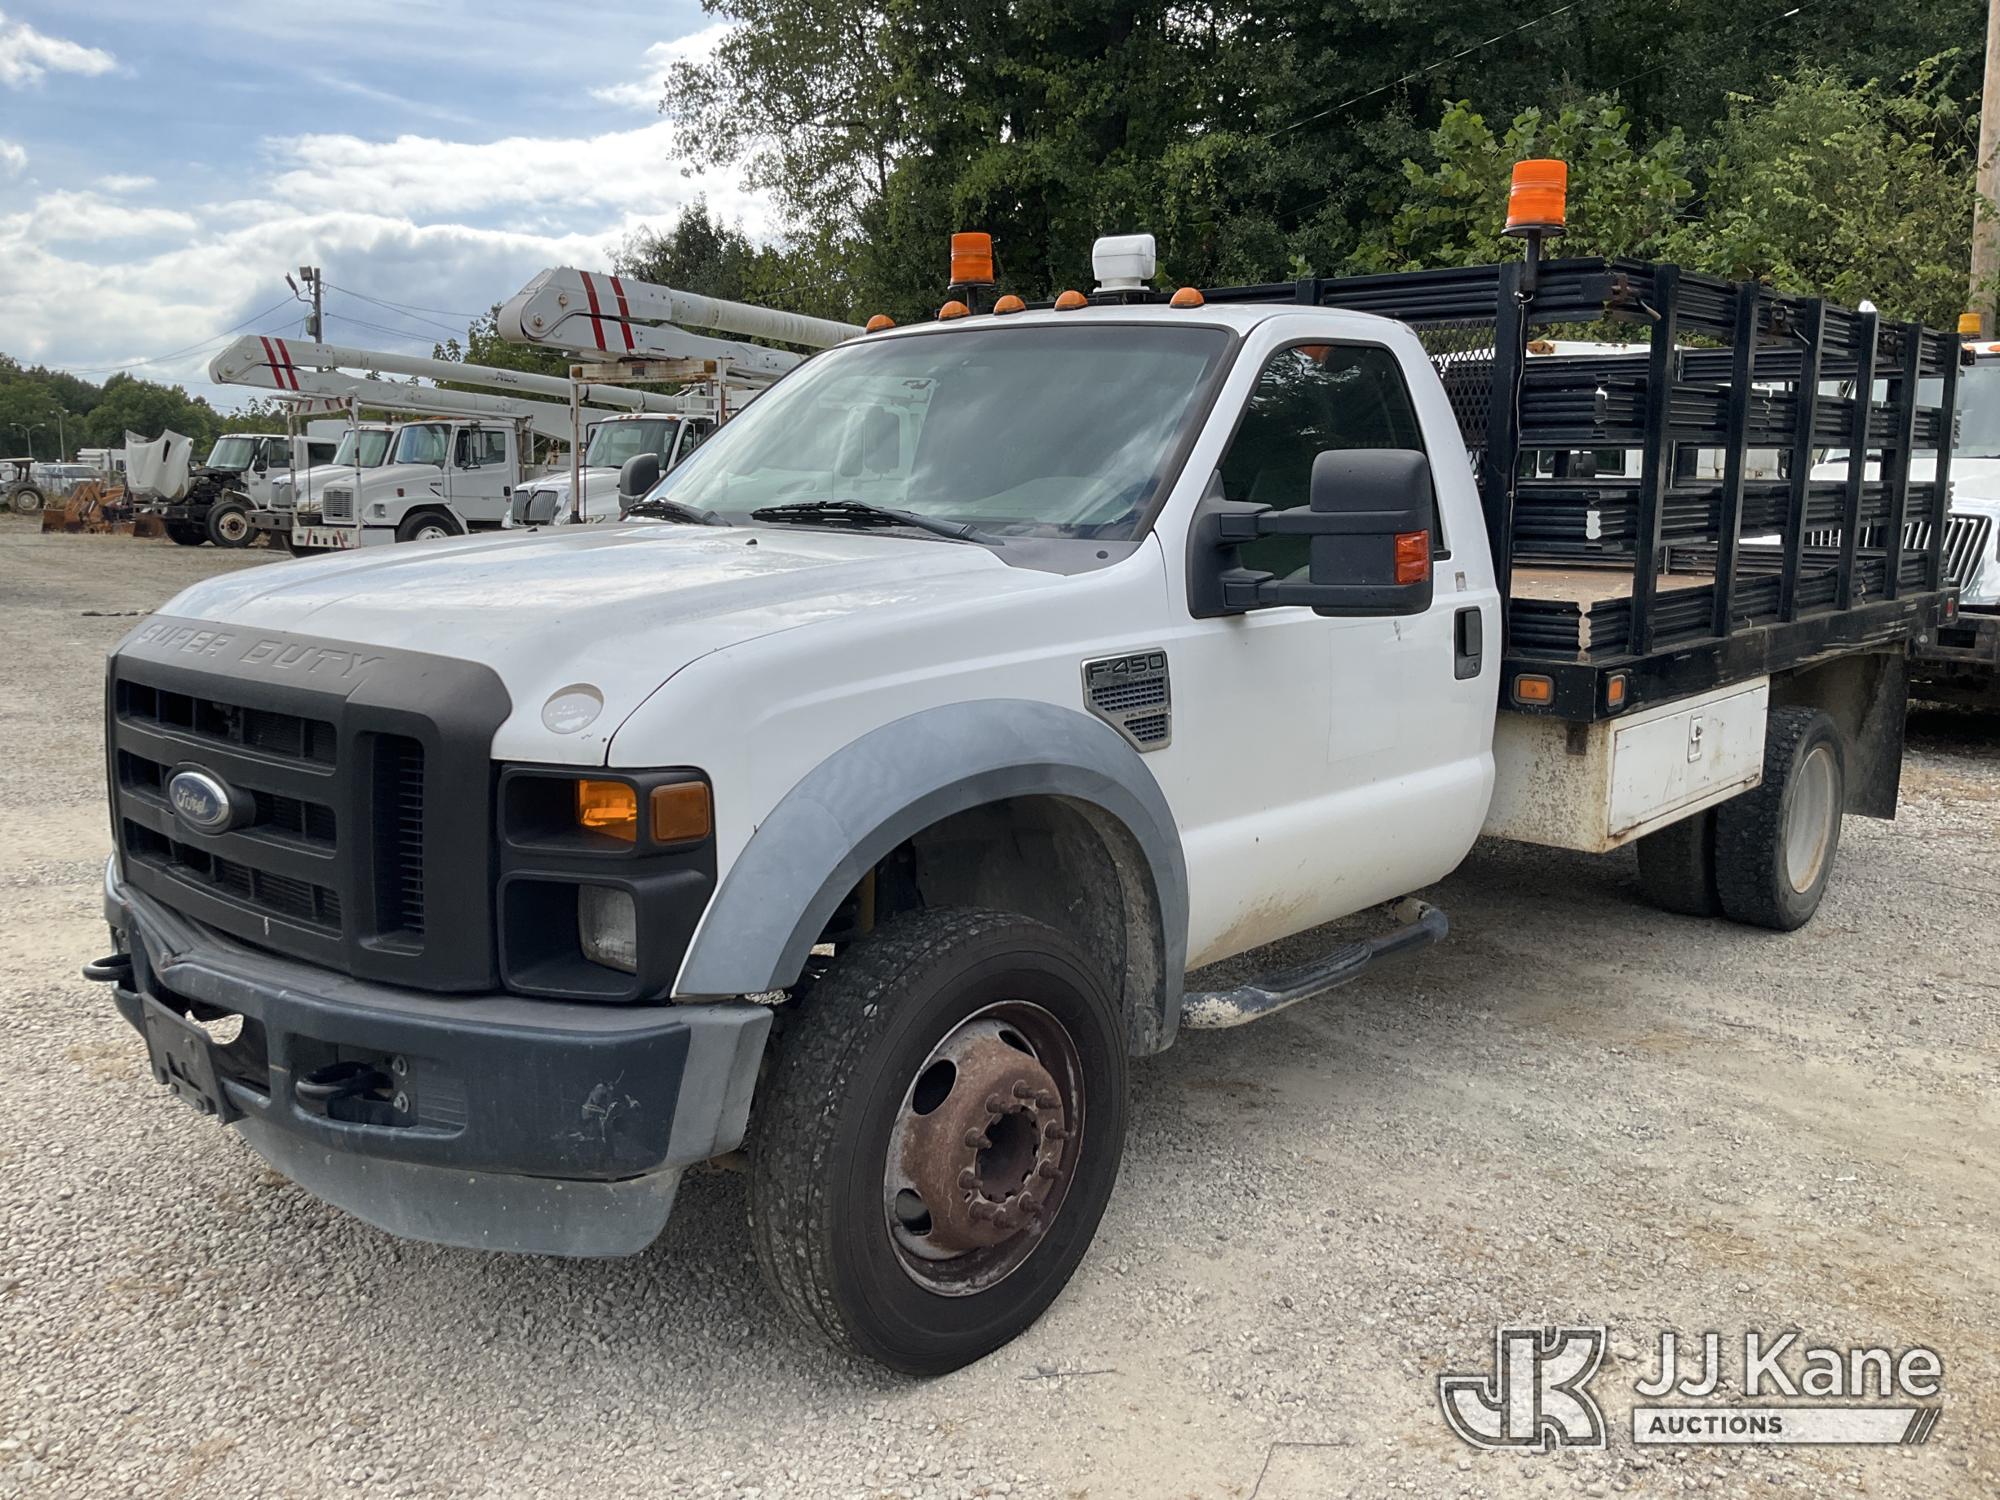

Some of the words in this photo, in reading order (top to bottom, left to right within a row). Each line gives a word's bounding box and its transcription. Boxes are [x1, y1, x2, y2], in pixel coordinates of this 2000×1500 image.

[136, 623, 236, 657] SUPER
[240, 639, 385, 679] DUTY
[1089, 653, 1164, 680] F-450
[176, 785, 209, 815] Ford
